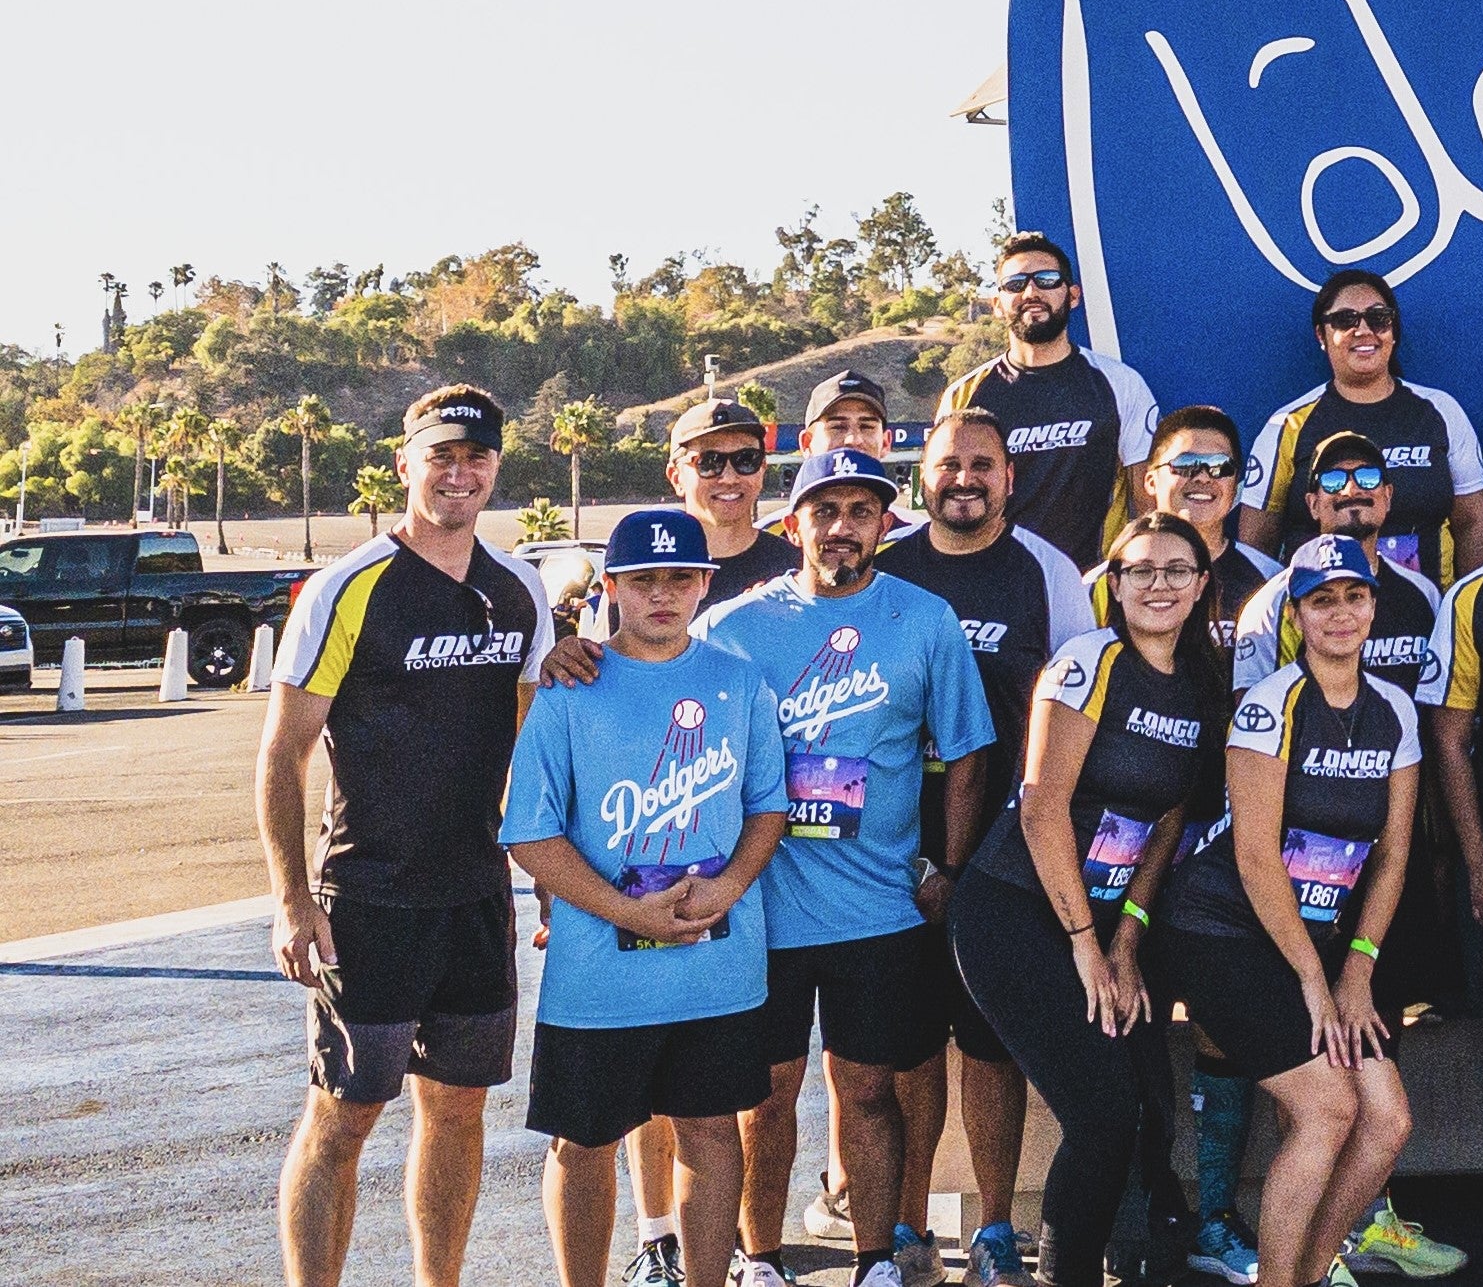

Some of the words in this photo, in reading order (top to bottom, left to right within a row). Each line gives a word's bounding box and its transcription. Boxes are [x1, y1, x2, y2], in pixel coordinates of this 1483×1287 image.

[1007, 420, 1092, 446] ONGO
[1008, 444, 1031, 454] OTA
[833, 453, 857, 476] LA
[651, 523, 676, 553] LA
[1361, 636, 1426, 657] ONGO
[404, 656, 458, 671] TOYOTA
[459, 653, 521, 665] LEXUS
[779, 662, 889, 741] odgers
[1127, 707, 1201, 740] LONGO
[1302, 748, 1391, 770] LONGO
[1303, 766, 1345, 778] TOYOTA
[600, 737, 738, 850] Dodgers
[788, 802, 833, 823] 2413
[1301, 882, 1340, 907] 1861
[637, 940, 652, 950] 5K
